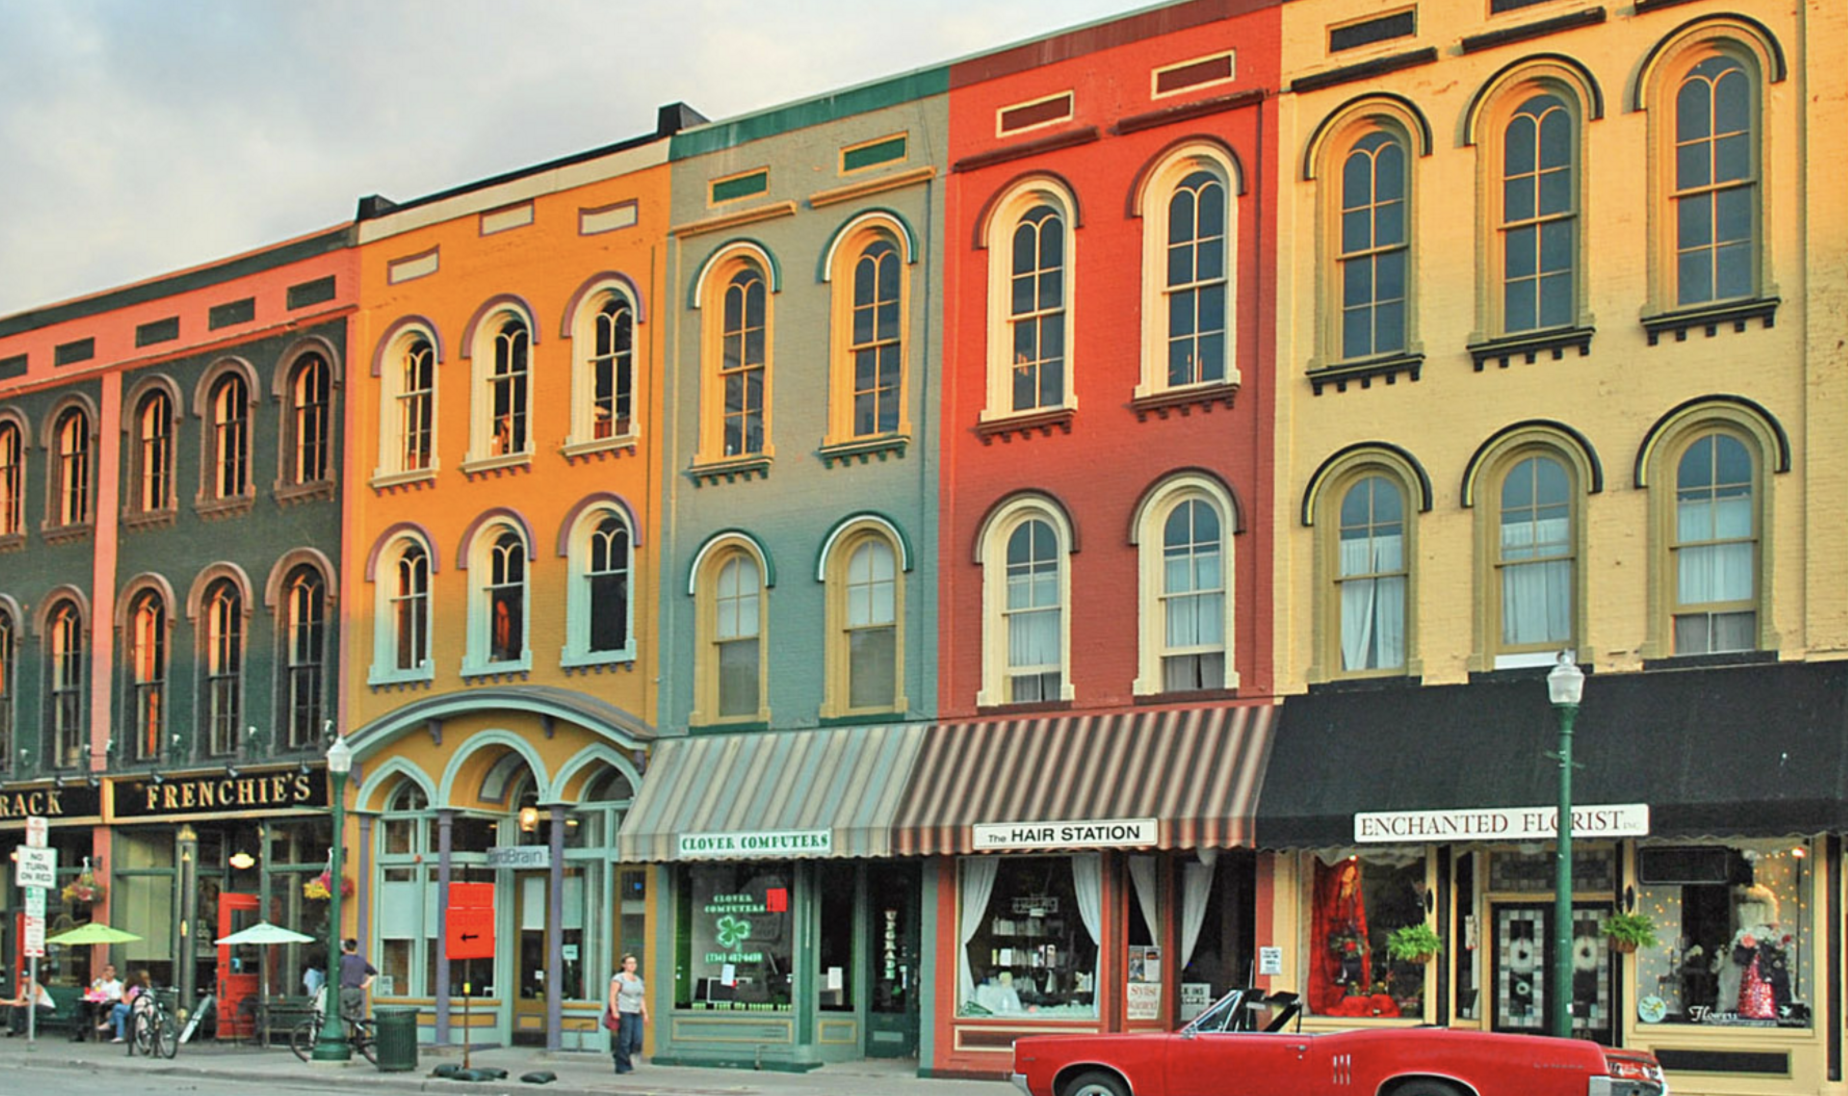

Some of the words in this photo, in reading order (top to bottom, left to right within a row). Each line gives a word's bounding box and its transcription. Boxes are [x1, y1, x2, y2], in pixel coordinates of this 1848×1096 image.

[146, 772, 311, 810] FRENCHIE'S
[1360, 813, 1509, 836] ENCHANTED
[681, 837, 736, 850] CLOVER
[740, 834, 829, 849] COMPUTERS
[988, 834, 1007, 844] The
[1011, 828, 1055, 842] HAIR
[1060, 825, 1141, 841] STATION
[30, 852, 44, 861] NO
[25, 862, 49, 872] TURN
[20, 871, 33, 881] ON
[35, 872, 53, 882] RED
